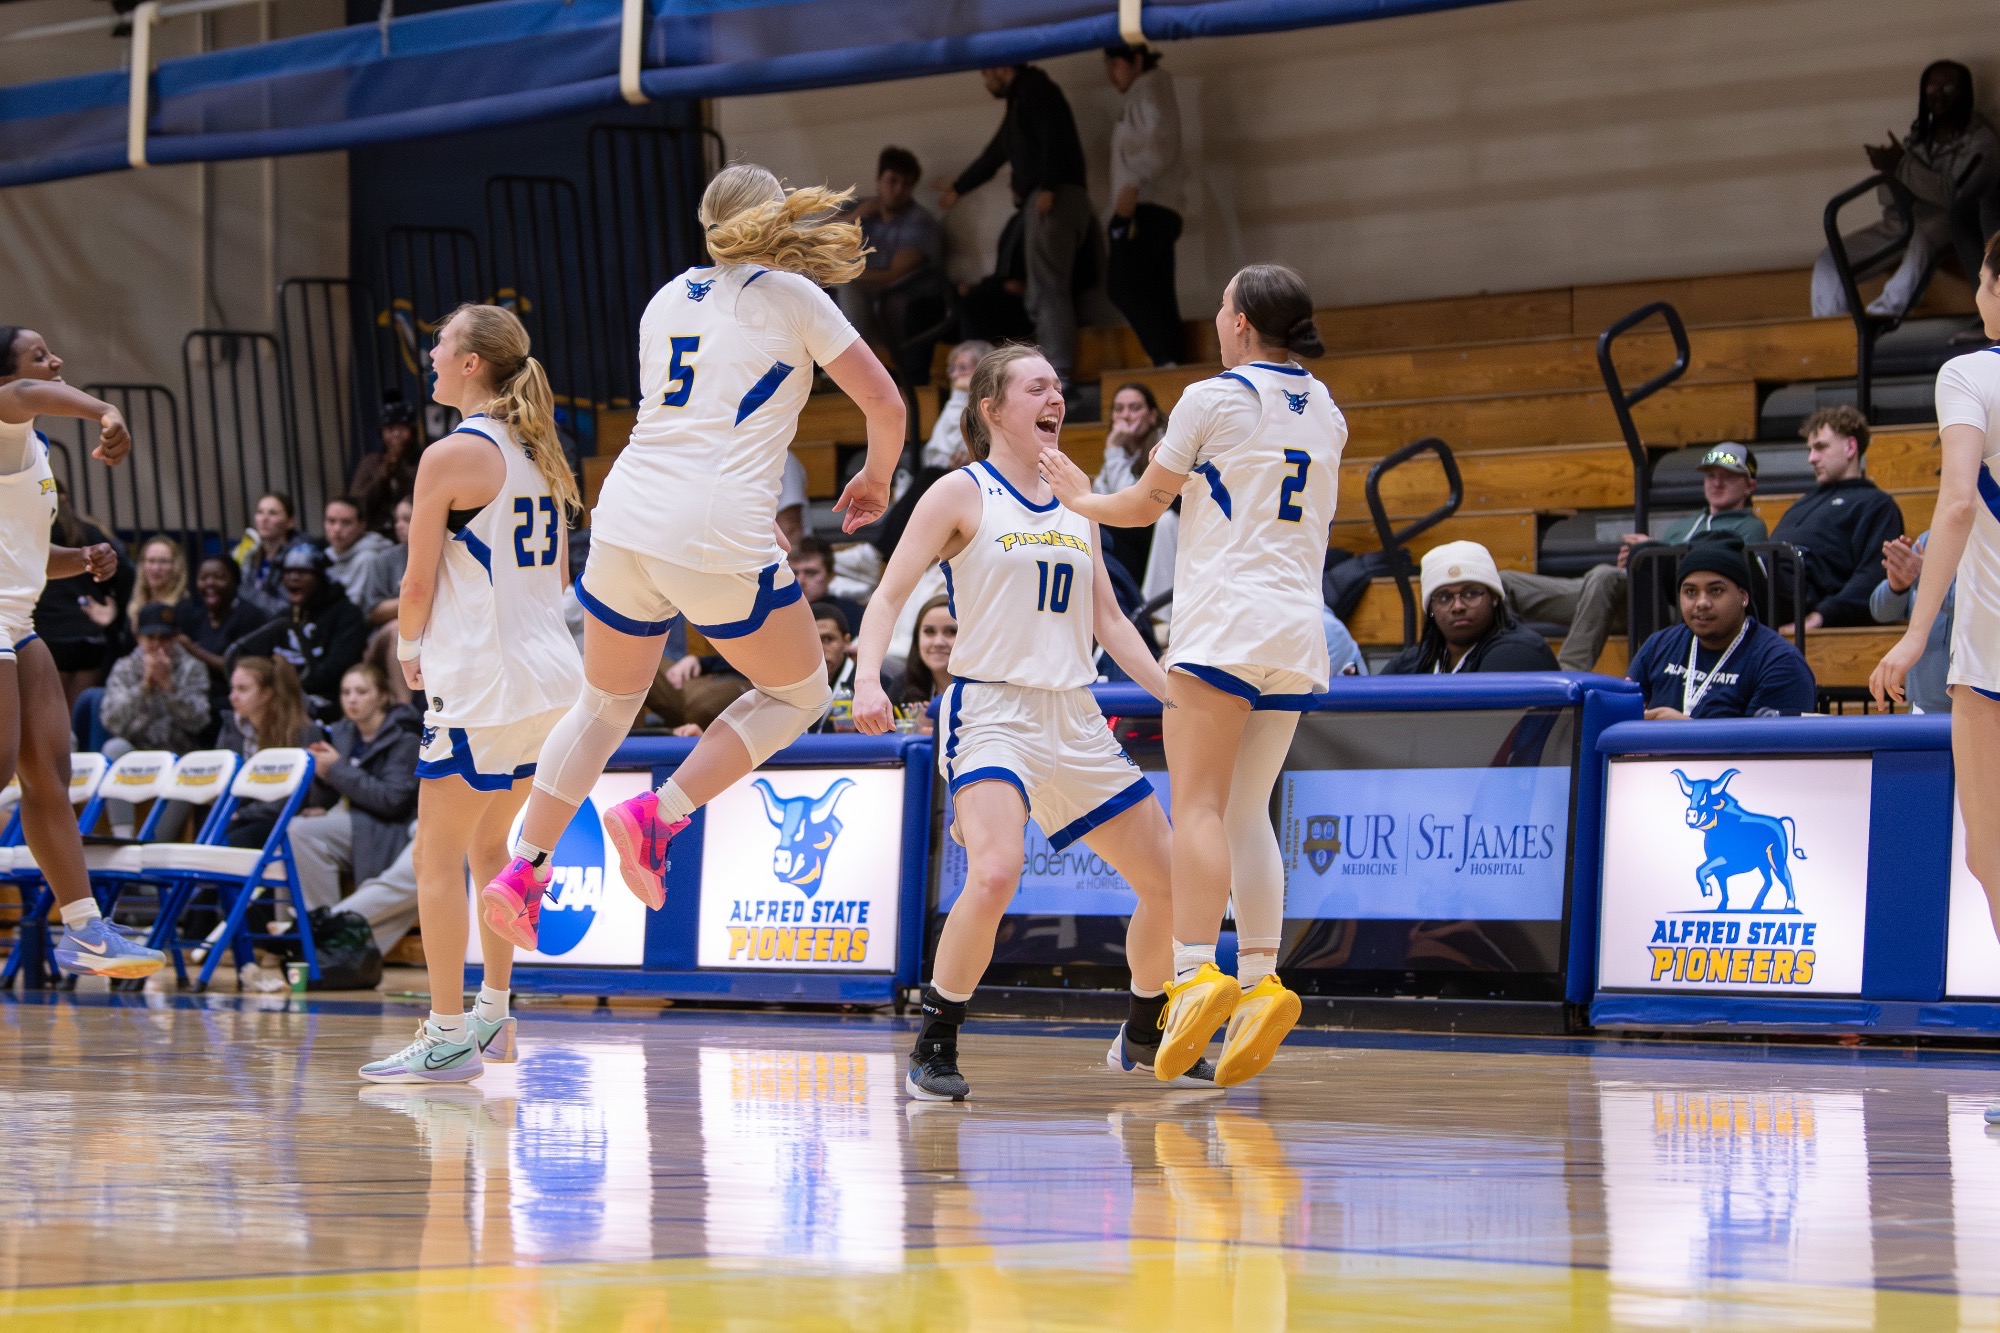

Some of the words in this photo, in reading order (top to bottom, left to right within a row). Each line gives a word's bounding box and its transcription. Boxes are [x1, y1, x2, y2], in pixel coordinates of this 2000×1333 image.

[660, 333, 702, 410] 5
[1277, 447, 1312, 524] 2
[514, 494, 559, 569] 23
[1036, 560, 1074, 613] 10
[1712, 672, 1739, 685] TATE
[1345, 814, 1398, 860] UR
[1342, 863, 1398, 875] MEDICINE
[1470, 863, 1525, 876] HOSPITAL
[541, 866, 603, 912] CAA
[730, 900, 804, 923] ALFRED
[811, 900, 870, 923] STATE
[726, 926, 870, 962] PIONEERS
[1651, 920, 1741, 944] ALFRED
[1747, 922, 1817, 946] STATE
[1646, 946, 1816, 985] PIONEERS
